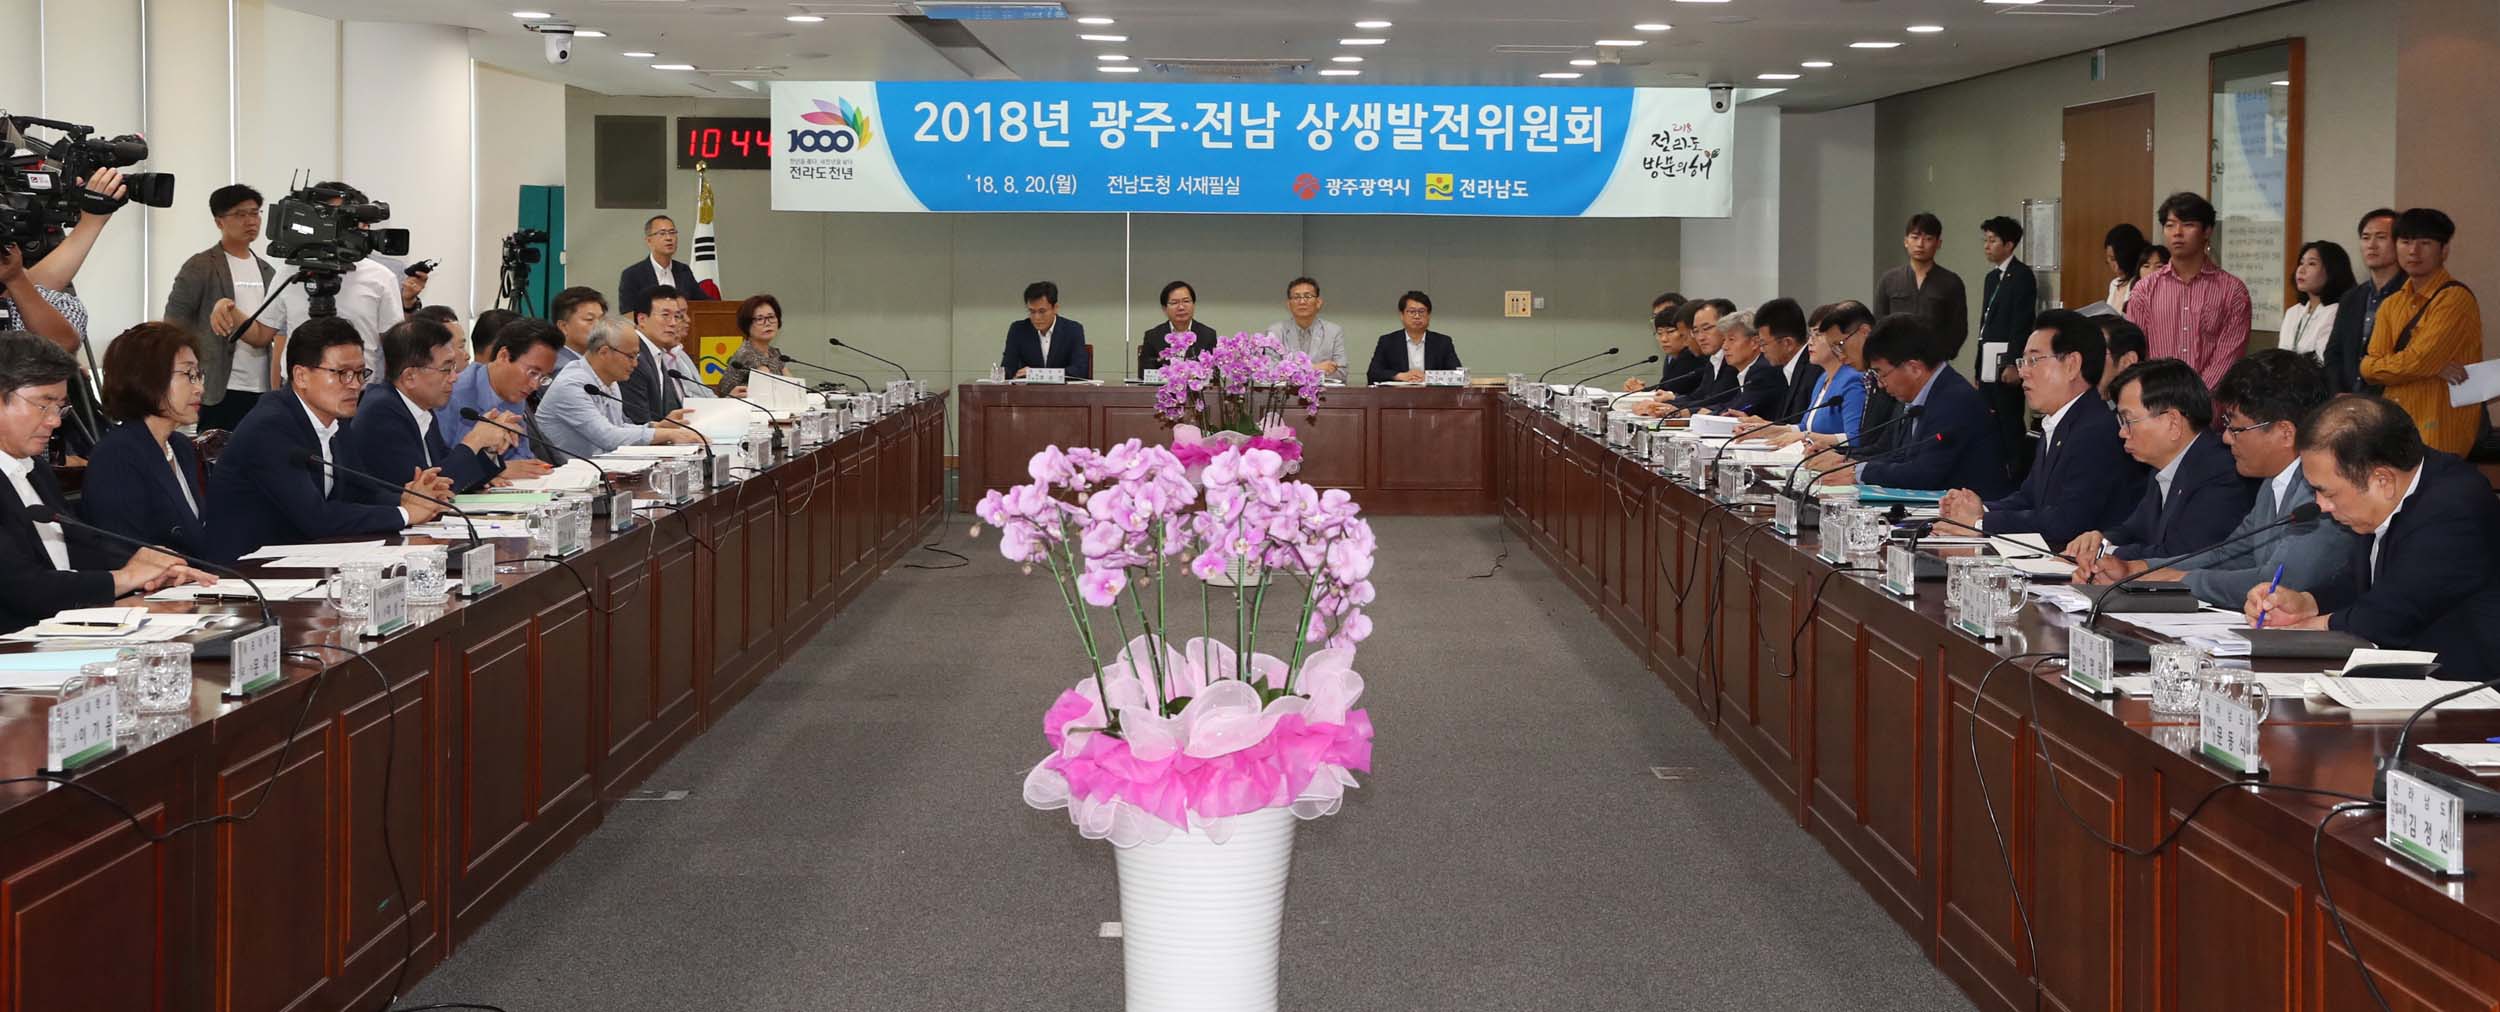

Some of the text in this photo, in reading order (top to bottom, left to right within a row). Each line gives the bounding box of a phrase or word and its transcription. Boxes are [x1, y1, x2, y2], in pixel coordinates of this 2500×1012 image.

[913, 100, 1603, 152] 2018년 광주·전남 상생발전위원회
[787, 129, 854, 153] 1000
[1651, 130, 1705, 152] 전라도
[1003, 176, 1019, 194] 8.
[1107, 175, 1241, 195] 전남도청 서재필실
[1325, 178, 1411, 197] 광주광역시
[1459, 179, 1529, 198] 전라남도
[2408, 813, 2449, 855] 김정선
